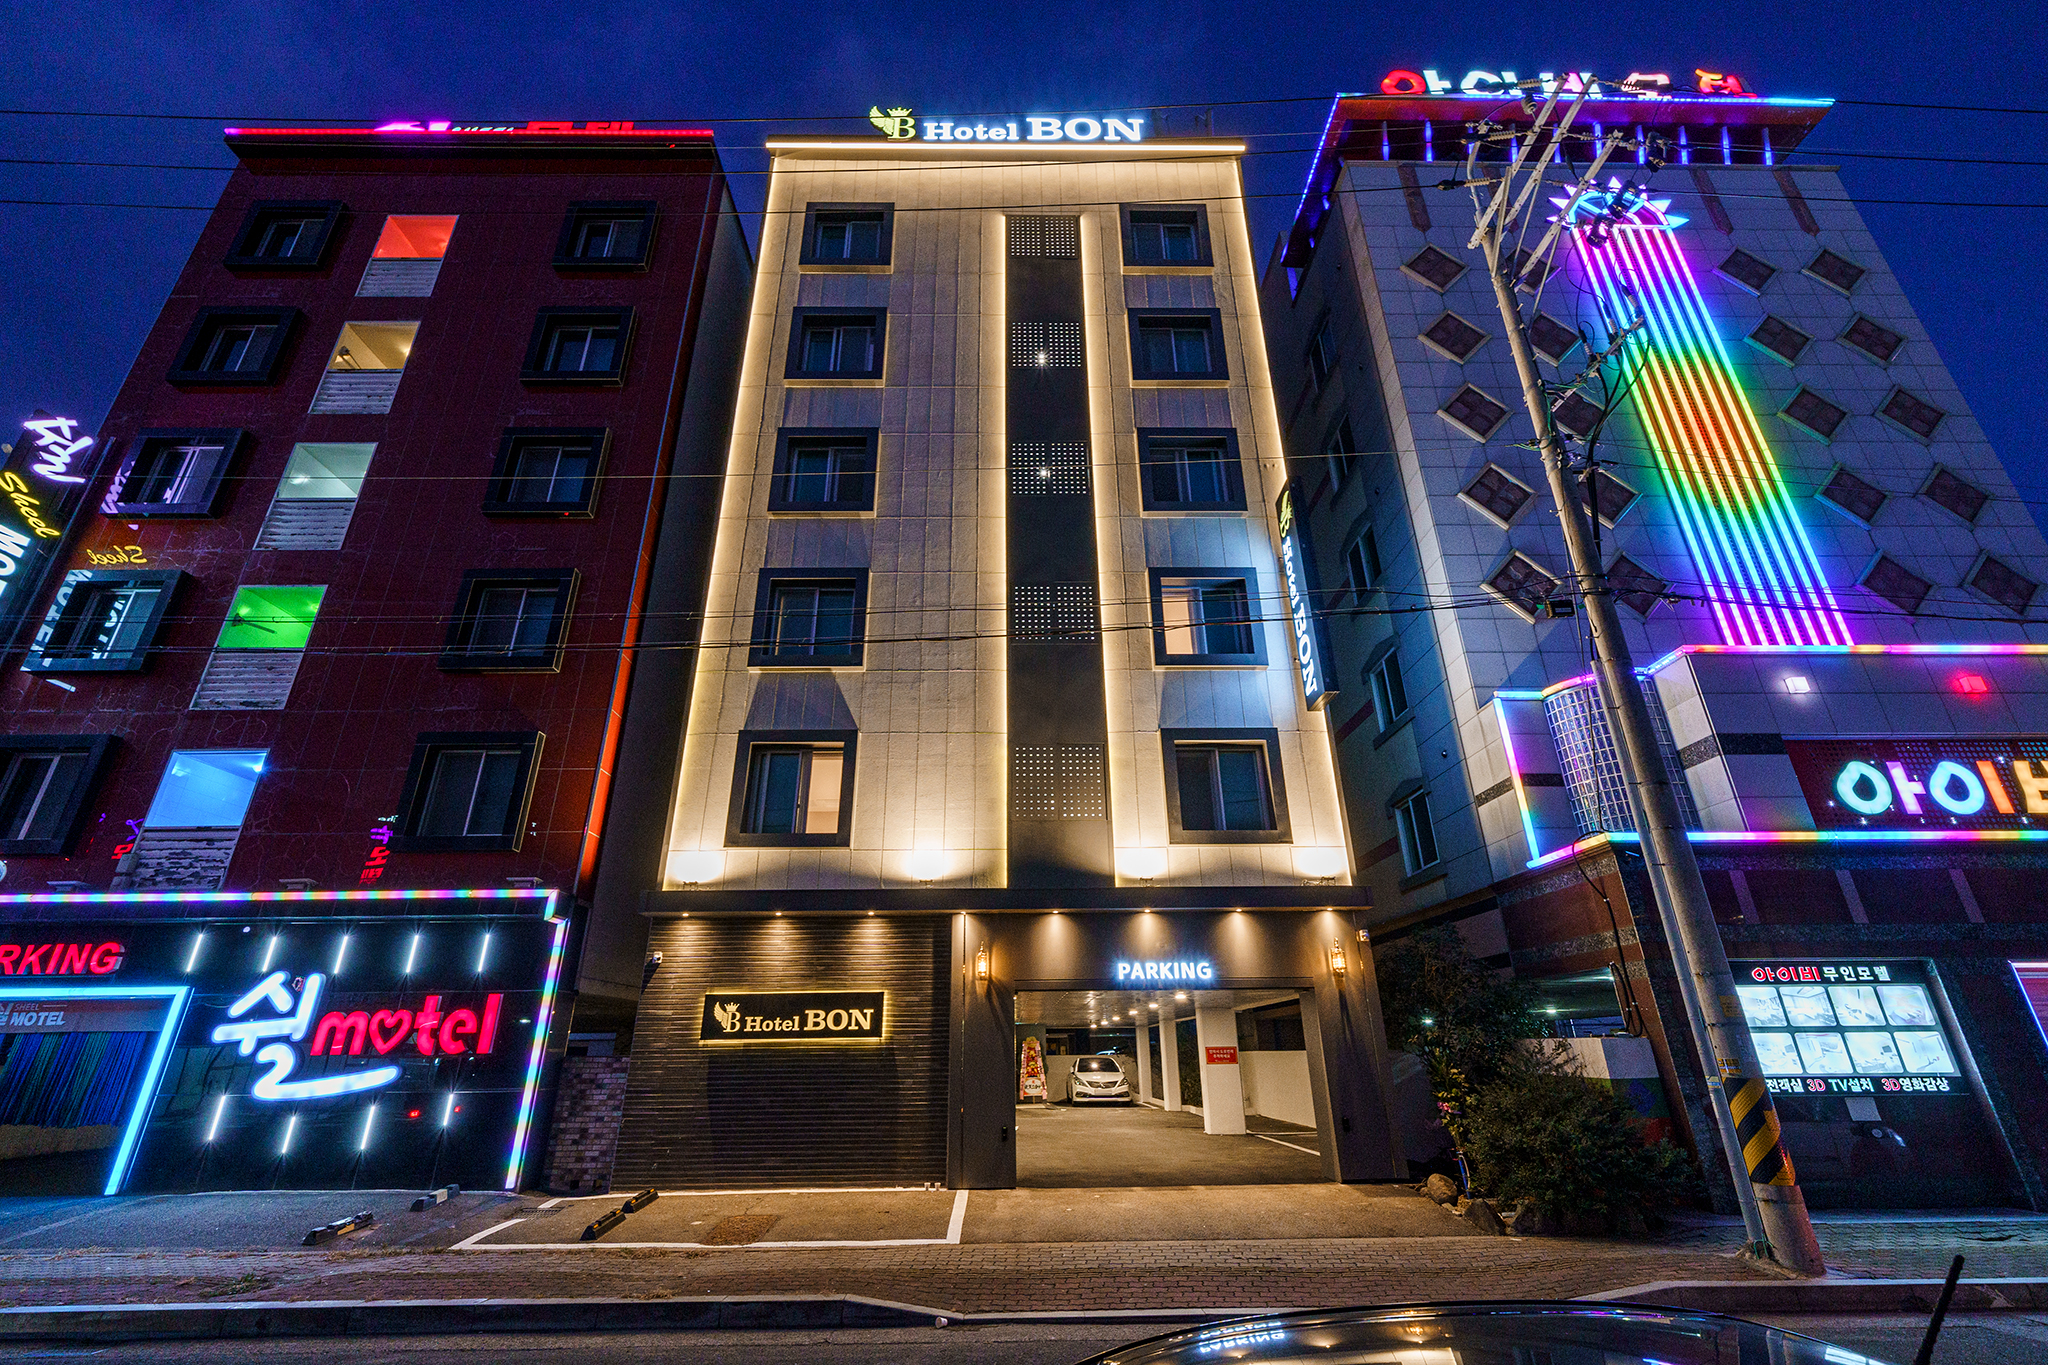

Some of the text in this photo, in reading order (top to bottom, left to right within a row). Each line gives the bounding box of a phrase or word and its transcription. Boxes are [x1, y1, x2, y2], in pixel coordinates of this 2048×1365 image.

[923, 122, 1020, 141] Hotel
[1026, 116, 1144, 141] BON
[0, 471, 61, 539] Sheel
[1282, 536, 1299, 609] Hotel
[1293, 603, 1318, 697] BON
[1117, 961, 1213, 980] PARKING
[1751, 965, 1891, 982] 아이비 무인모텔
[14, 1003, 40, 1011] SHEEL
[9, 1011, 66, 1027] MOTEL
[743, 1015, 800, 1032] Hotel
[803, 1009, 874, 1031] BON
[1806, 1078, 1826, 1092] 3D
